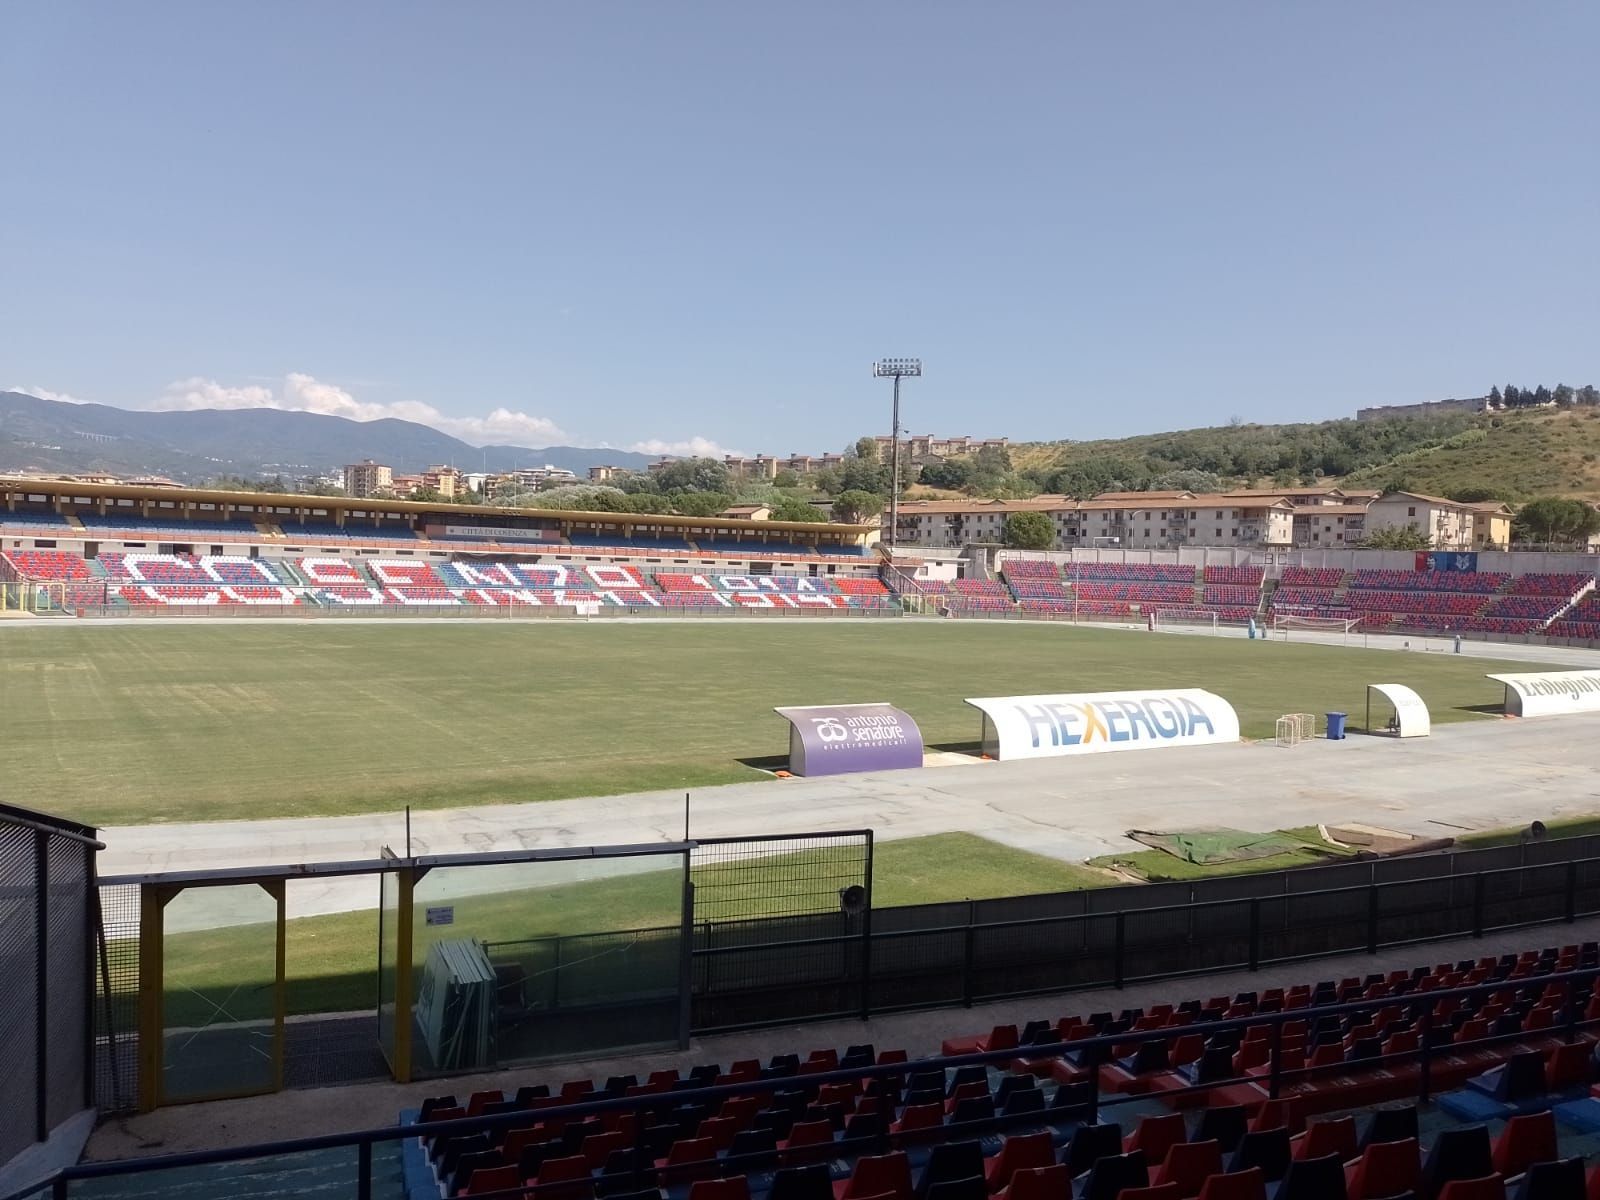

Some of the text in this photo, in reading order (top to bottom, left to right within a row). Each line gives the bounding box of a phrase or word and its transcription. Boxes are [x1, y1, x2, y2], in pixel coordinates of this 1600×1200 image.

[494, 529, 527, 537] COSENZA
[847, 715, 898, 727] antonio
[1014, 696, 1215, 748] HEXERGIA
[852, 725, 905, 741] senatore
[823, 739, 907, 750] elettromedicali
